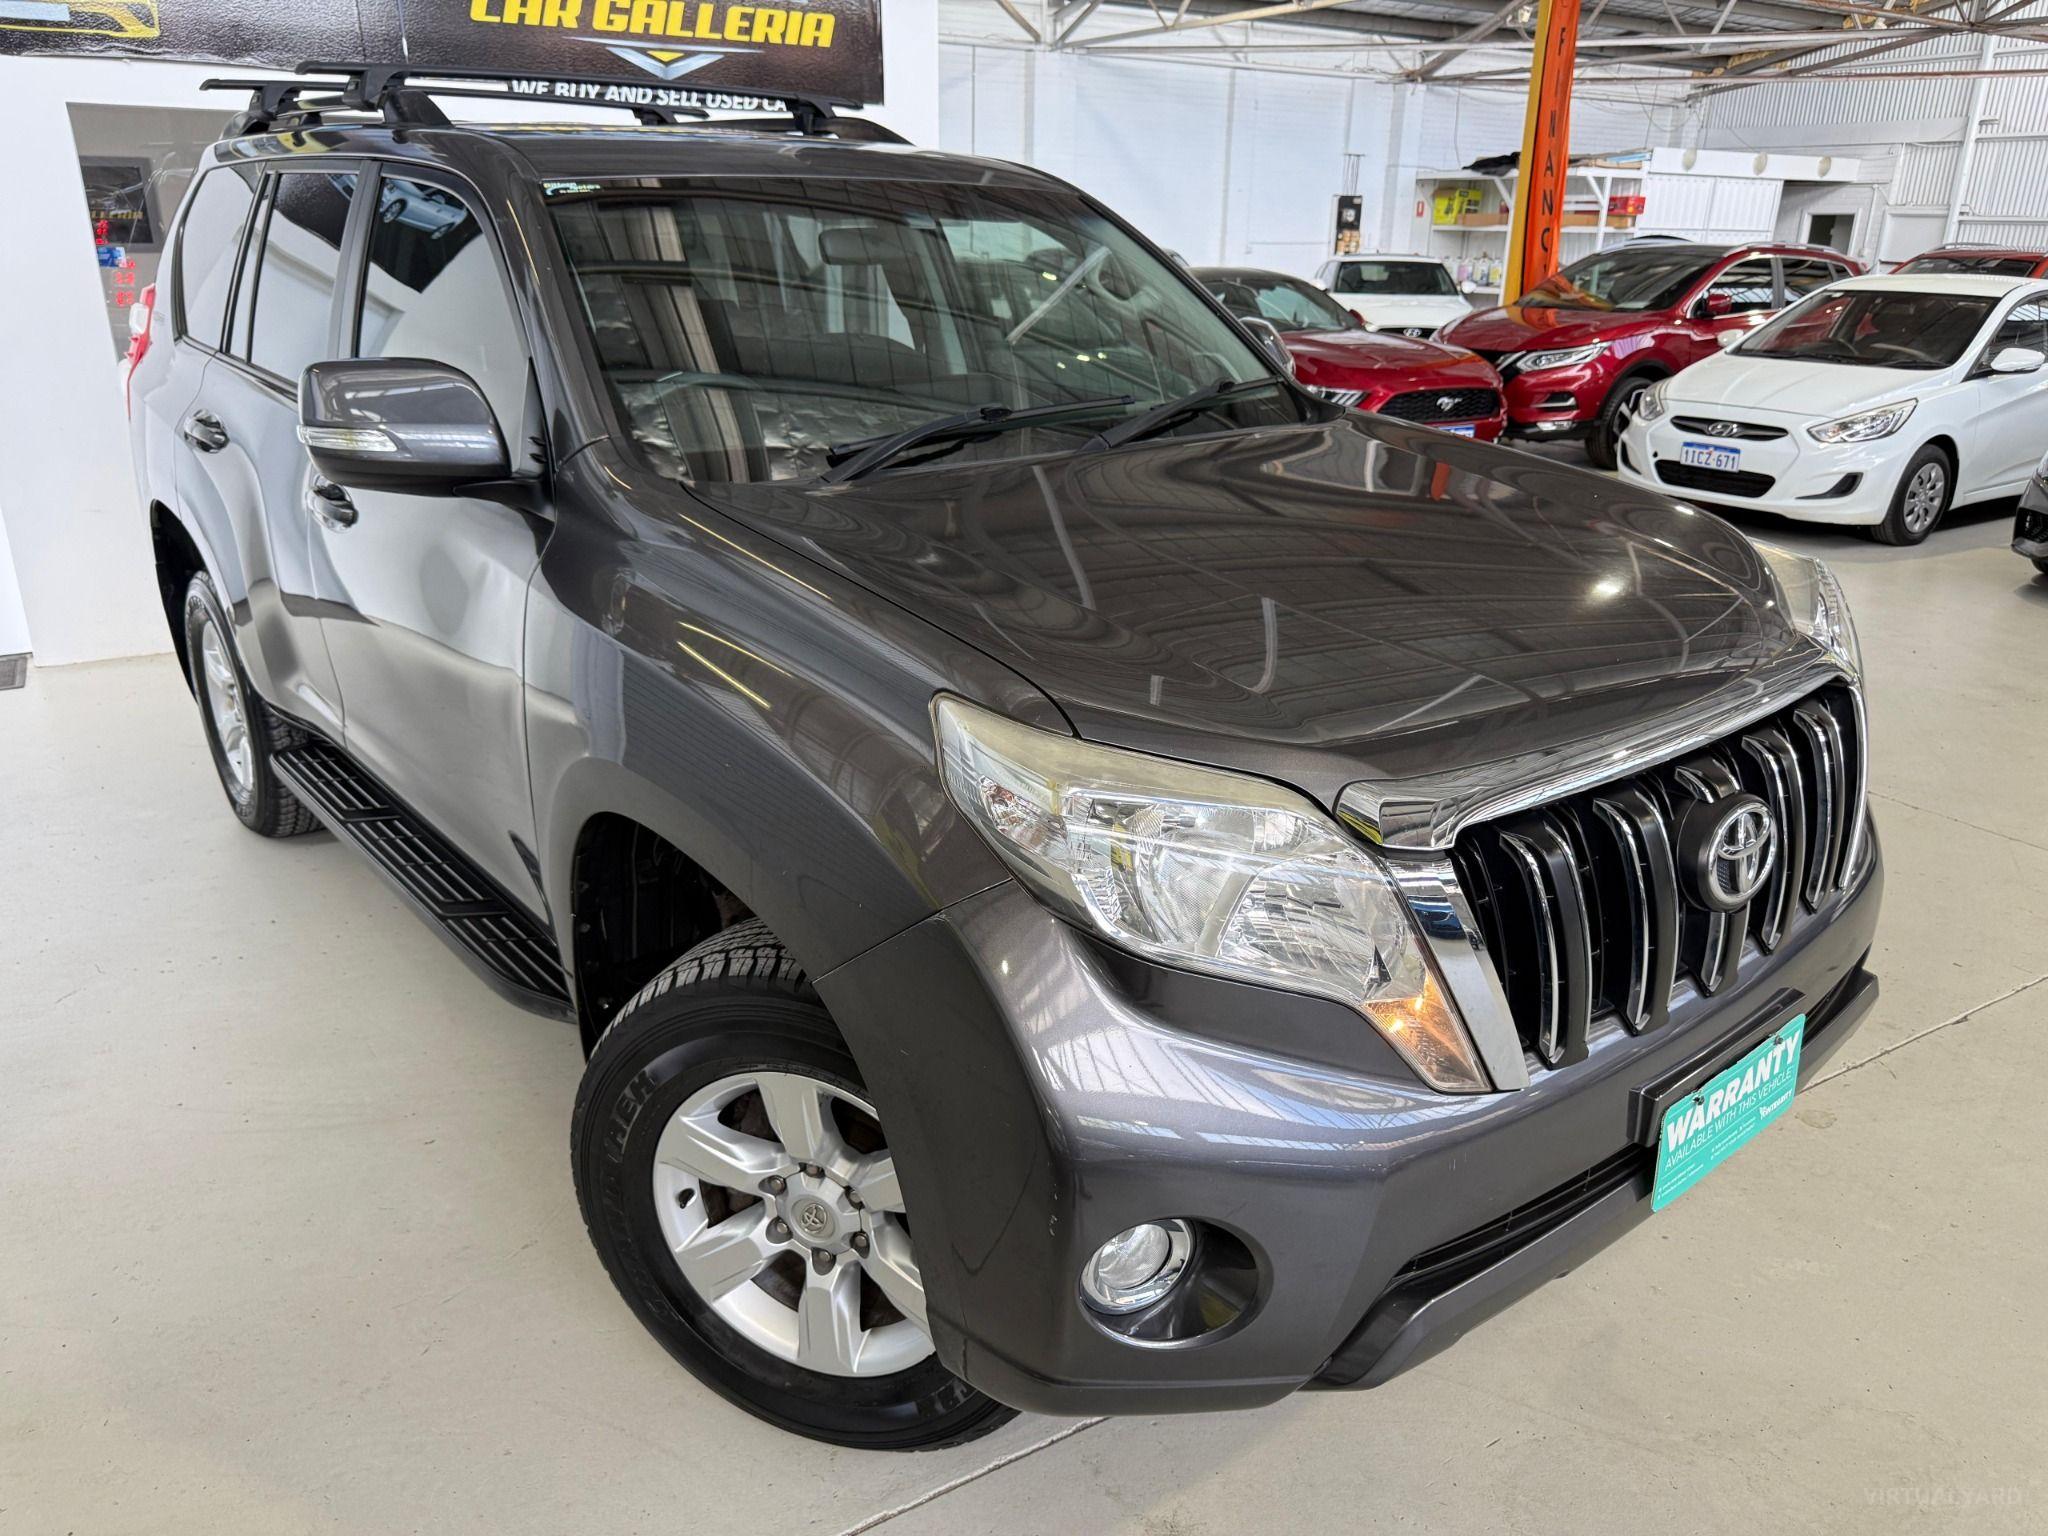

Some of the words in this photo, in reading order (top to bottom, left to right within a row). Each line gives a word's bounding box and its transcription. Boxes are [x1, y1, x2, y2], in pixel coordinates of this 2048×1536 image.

[592, 0, 836, 47] GALLERIA
[604, 85, 652, 104] AND
[656, 89, 701, 107] SELL
[705, 93, 758, 110] USED
[762, 98, 787, 112] CA
[1540, 27, 1566, 273] FINANC
[1665, 1125, 1713, 1171] AVAILABLE
[1715, 1107, 1737, 1133] WITH
[1739, 1093, 1757, 1114] THIS
[1758, 1067, 1792, 1099] VEHICLE
[1667, 1031, 1799, 1152] WARRANTY
